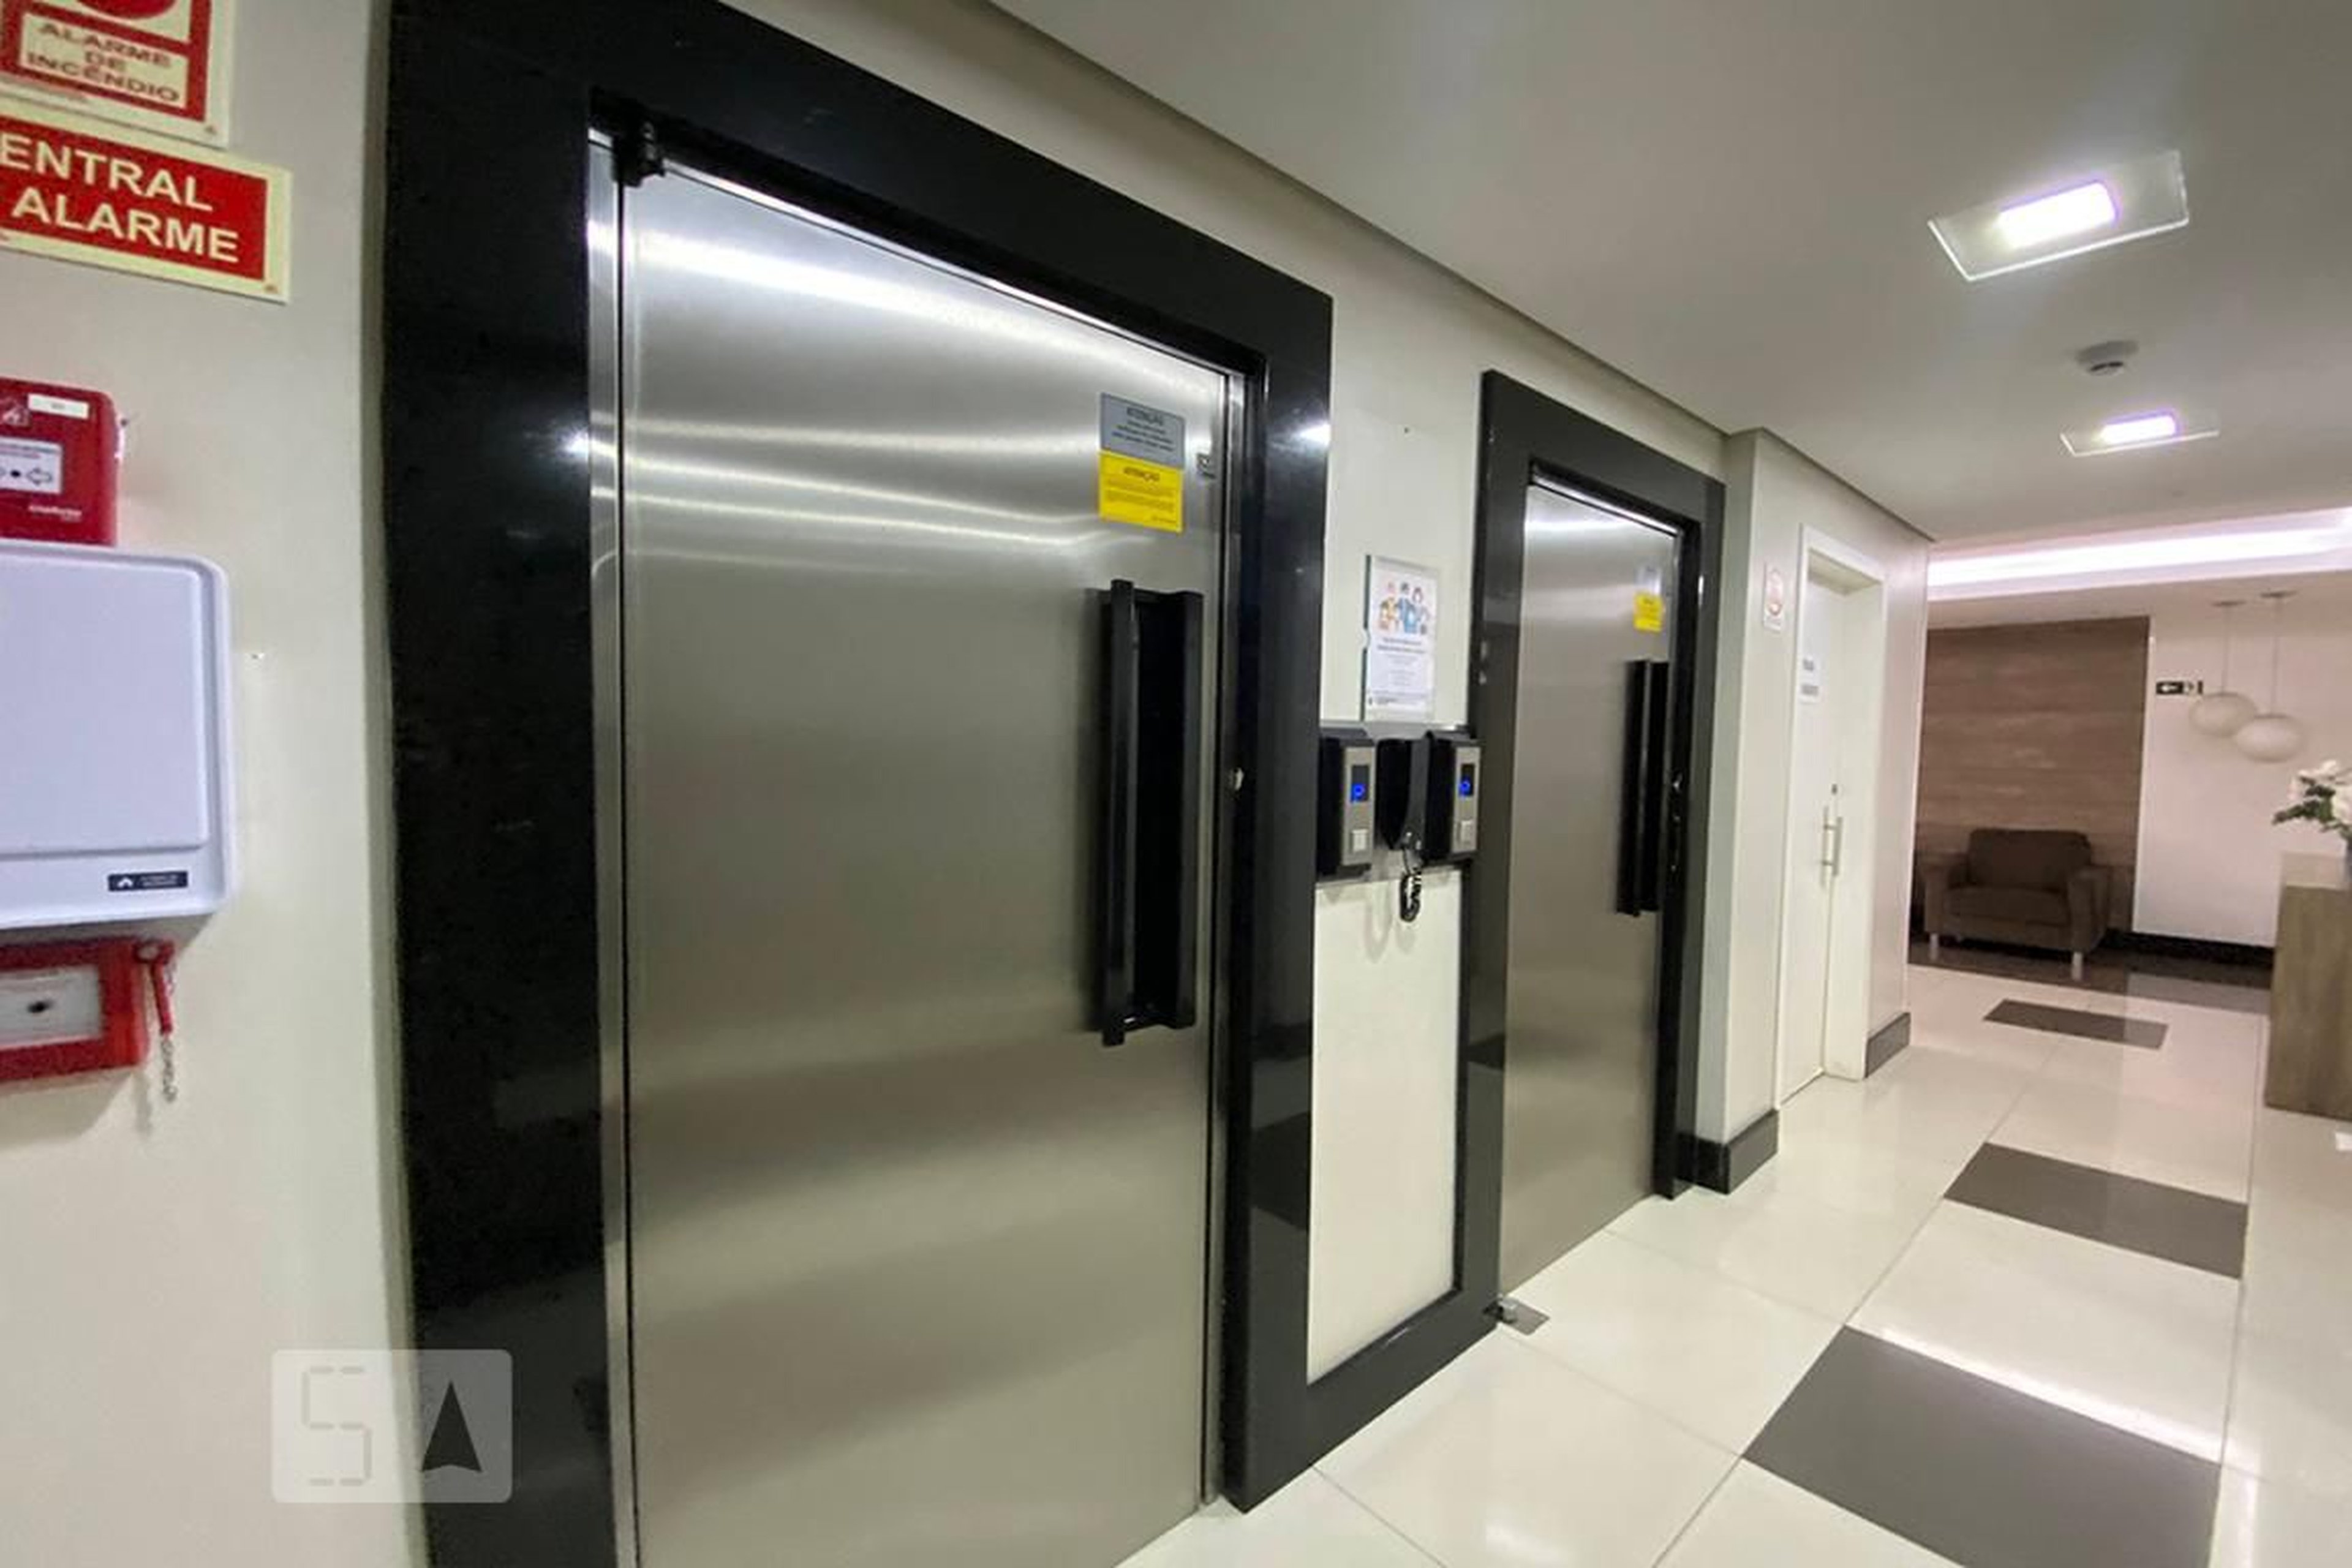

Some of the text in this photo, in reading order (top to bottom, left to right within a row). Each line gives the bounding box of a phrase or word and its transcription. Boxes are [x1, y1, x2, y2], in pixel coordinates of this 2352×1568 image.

[38, 23, 172, 69] ALARME
[85, 50, 126, 72] DE
[26, 52, 180, 102] INCÊNDIO
[11, 186, 239, 263] ALARME
